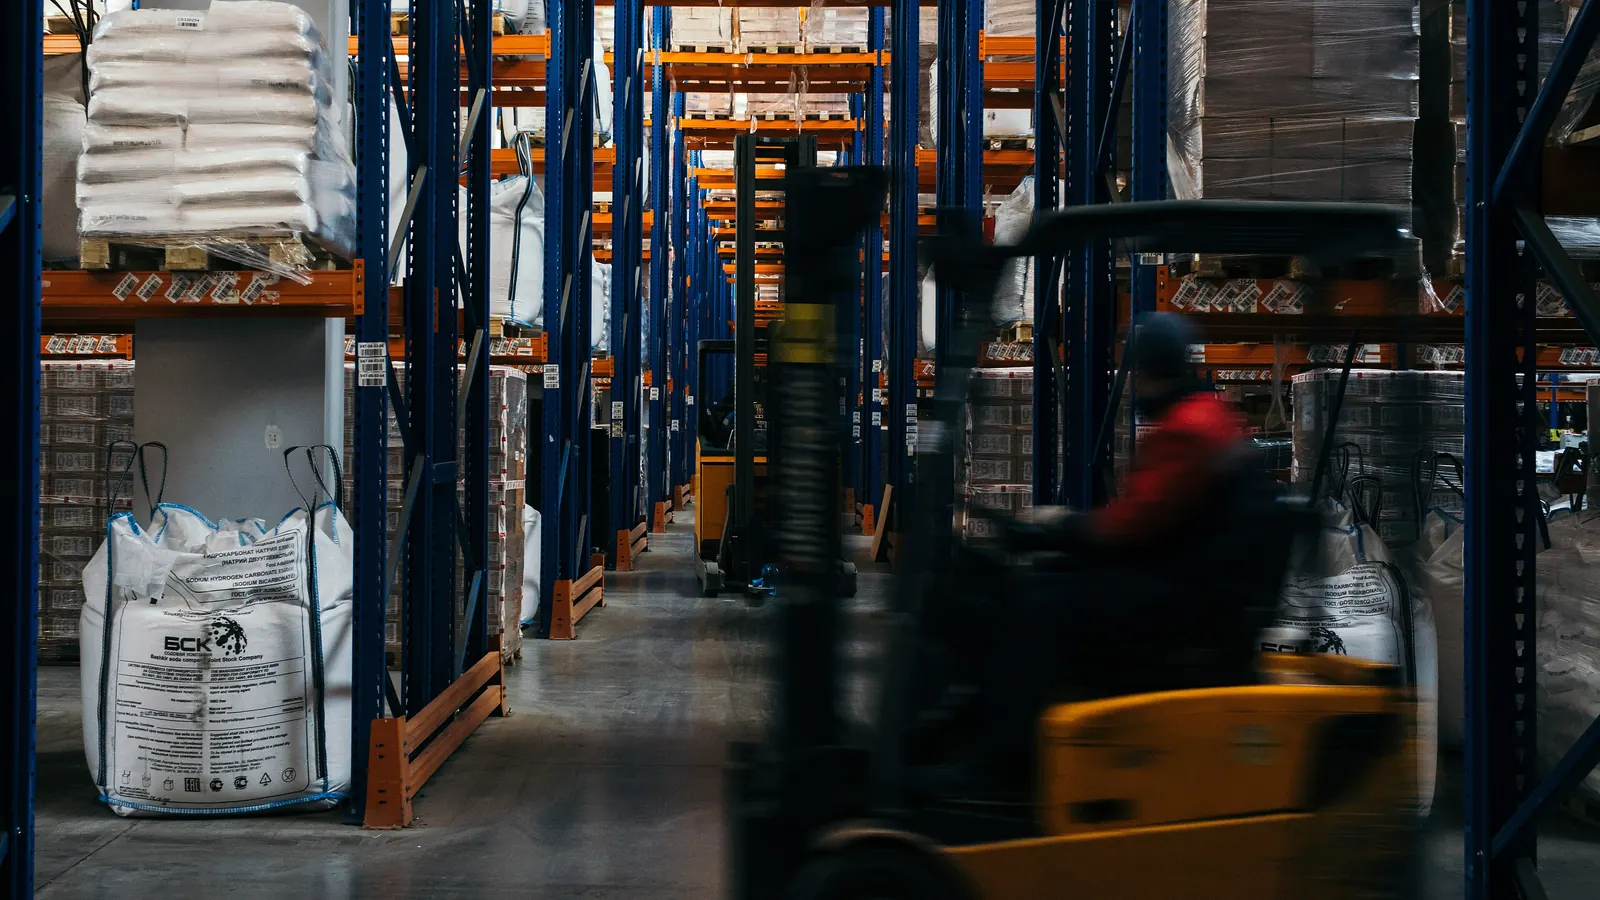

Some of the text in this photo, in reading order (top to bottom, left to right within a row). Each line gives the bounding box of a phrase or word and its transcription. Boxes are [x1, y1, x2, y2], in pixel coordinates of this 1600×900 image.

[256, 546, 278, 554] НАТРИЯ
[210, 574, 244, 582] HYDROGEN
[244, 570, 278, 579] CARBONATE
[1334, 582, 1365, 590] CARBONATE
[164, 636, 212, 652] БСК
[238, 654, 263, 662] Company
